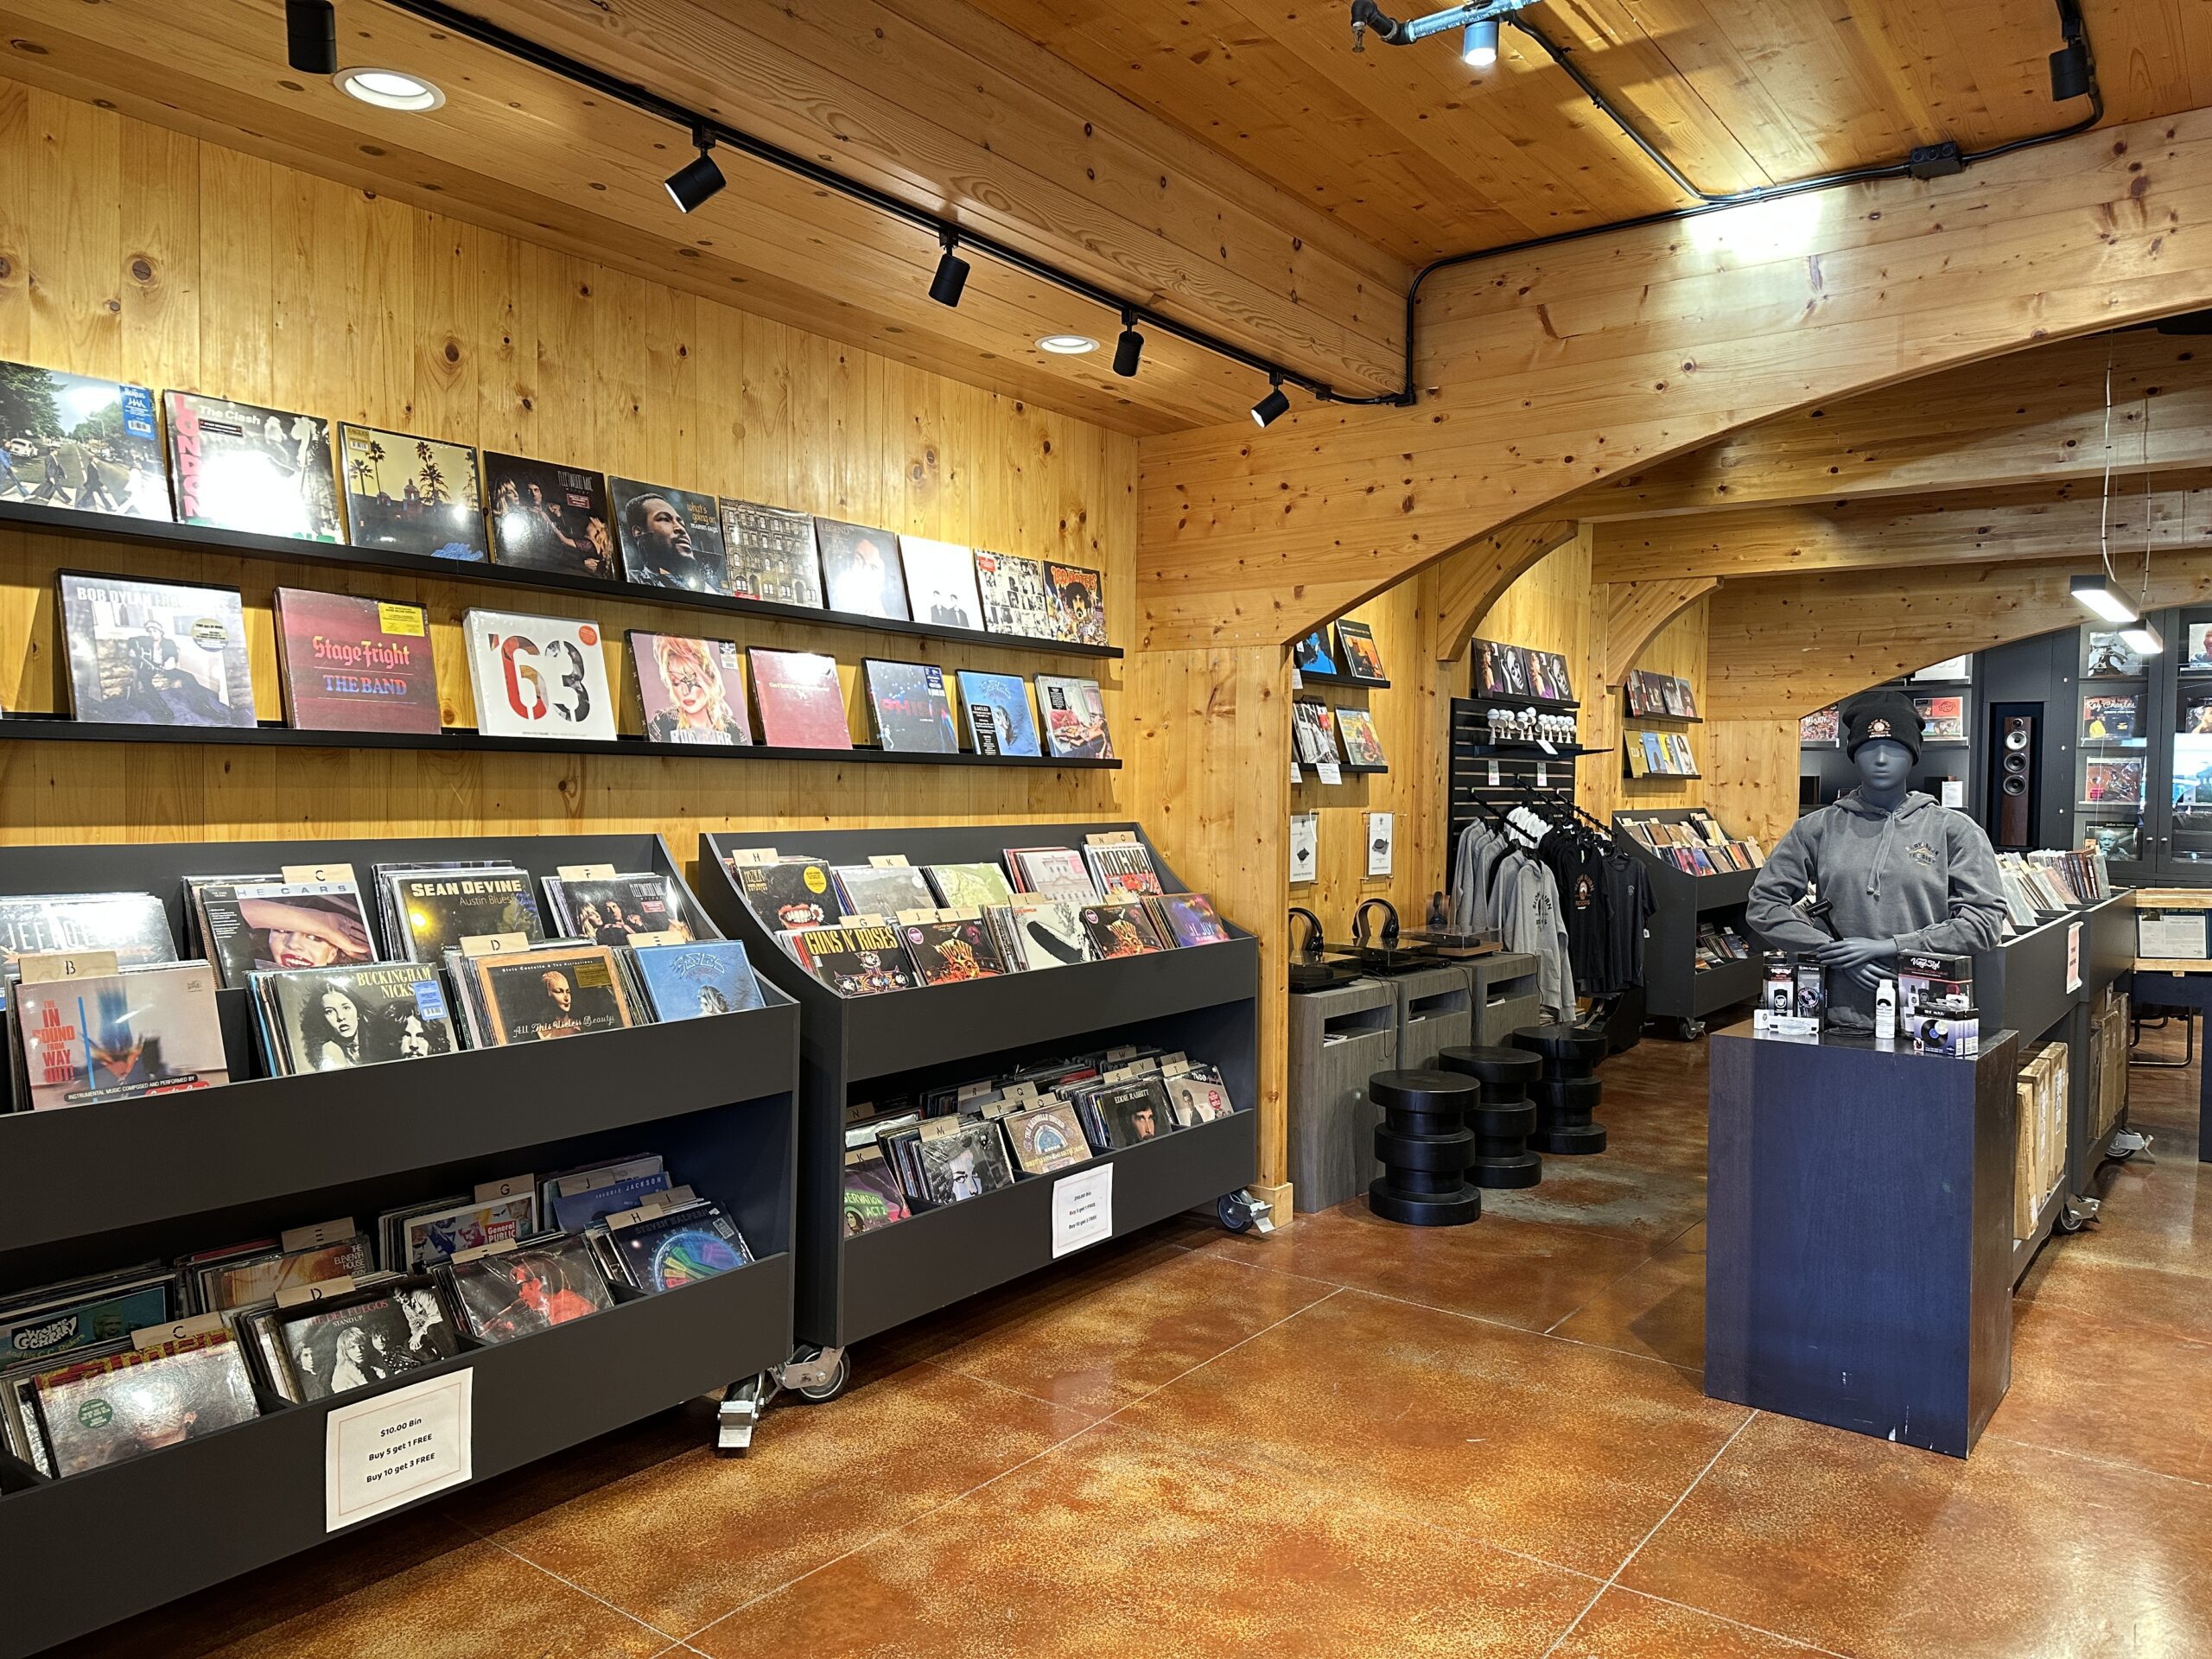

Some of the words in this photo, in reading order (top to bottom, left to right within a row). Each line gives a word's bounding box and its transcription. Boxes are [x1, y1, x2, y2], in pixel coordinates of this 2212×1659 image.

[199, 404, 223, 419] The
[225, 410, 261, 426] Clash
[687, 502, 707, 513] what's
[820, 523, 850, 535] LEGEND
[77, 587, 106, 602] BOB
[110, 589, 152, 607] DYLAN
[312, 635, 362, 666] Stage
[361, 632, 410, 670] Fright
[322, 675, 359, 693] THE
[359, 677, 408, 696] BAND
[2103, 698, 2137, 709] Charles
[1098, 836, 1104, 845] N
[1120, 834, 1127, 842] O
[886, 858, 894, 867] K
[1095, 849, 1153, 876] MOGWAI
[316, 870, 327, 881] C
[280, 885, 347, 895] CARS
[410, 881, 461, 897] SEAN
[461, 879, 523, 895] DEVINE
[459, 895, 487, 906] Austin
[489, 894, 512, 905] Blues
[1024, 896, 1031, 906] L
[859, 918, 868, 927] G
[915, 912, 921, 922] J
[1201, 921, 1215, 936] JOY
[490, 939, 501, 951] D
[804, 931, 844, 956] GUNS
[841, 929, 856, 952] N'
[854, 926, 899, 952] ROSES
[66, 960, 76, 976] B
[355, 969, 433, 988] BUCKINGHAM
[380, 983, 415, 1000] NICKS
[43, 1000, 56, 1009] THE
[41, 1007, 61, 1028] IN
[512, 1024, 530, 1039] All
[531, 1022, 552, 1034] This
[552, 1019, 582, 1030] Useless
[582, 1014, 616, 1027] Beauty
[32, 1025, 76, 1044] SOUND
[47, 1041, 66, 1052] FROM
[42, 1049, 72, 1067] WAY
[1118, 1051, 1127, 1059] W
[1138, 1062, 1145, 1071] V
[43, 1065, 74, 1083] OUT!
[1116, 1072, 1122, 1081] S
[68, 1089, 105, 1100] INSTRUMENTAL
[105, 1086, 122, 1095] MUSIC
[122, 1082, 149, 1093] COMPOSED
[160, 1077, 188, 1087] PERFORMED
[972, 1086, 978, 1096] R
[1017, 1087, 1025, 1096] Q
[1114, 1093, 1130, 1105] EDDIE
[1129, 1088, 1150, 1102] RABBITT
[852, 1109, 861, 1118] N
[996, 1104, 1003, 1114] P
[936, 1125, 945, 1136] M
[856, 1153, 865, 1163] K
[586, 1177, 591, 1189] J
[626, 1176, 663, 1192] JACKSON
[500, 1183, 512, 1197] G
[665, 1193, 671, 1204] I
[631, 1211, 642, 1224] H
[867, 1205, 881, 1217] ACT
[882, 1206, 888, 1216] 2
[487, 1221, 516, 1236] General
[488, 1229, 517, 1244] PUBLIC
[351, 1243, 363, 1253] THE
[334, 1251, 365, 1265] ELEVENTH
[342, 1258, 365, 1270] HOUSE
[310, 1287, 322, 1300] D
[327, 1310, 347, 1323] DEL
[348, 1300, 389, 1318] FUEGOS
[332, 1317, 353, 1327] STAND
[353, 1313, 364, 1324] UP
[172, 1325, 187, 1339] C
[6, 1349, 22, 1358] and
[22, 1351, 35, 1359] his
[59, 1332, 86, 1352] Riders
[380, 1421, 408, 1438] $10.00
[408, 1417, 423, 1427] Bin
[368, 1451, 385, 1462] Buy
[385, 1447, 392, 1456] 5
[392, 1442, 407, 1455] get
[412, 1433, 433, 1446] FREE
[366, 1471, 383, 1484] Buy
[383, 1467, 394, 1477] 10
[394, 1462, 409, 1474] get
[409, 1459, 415, 1468] 3
[416, 1452, 435, 1465] FREE
